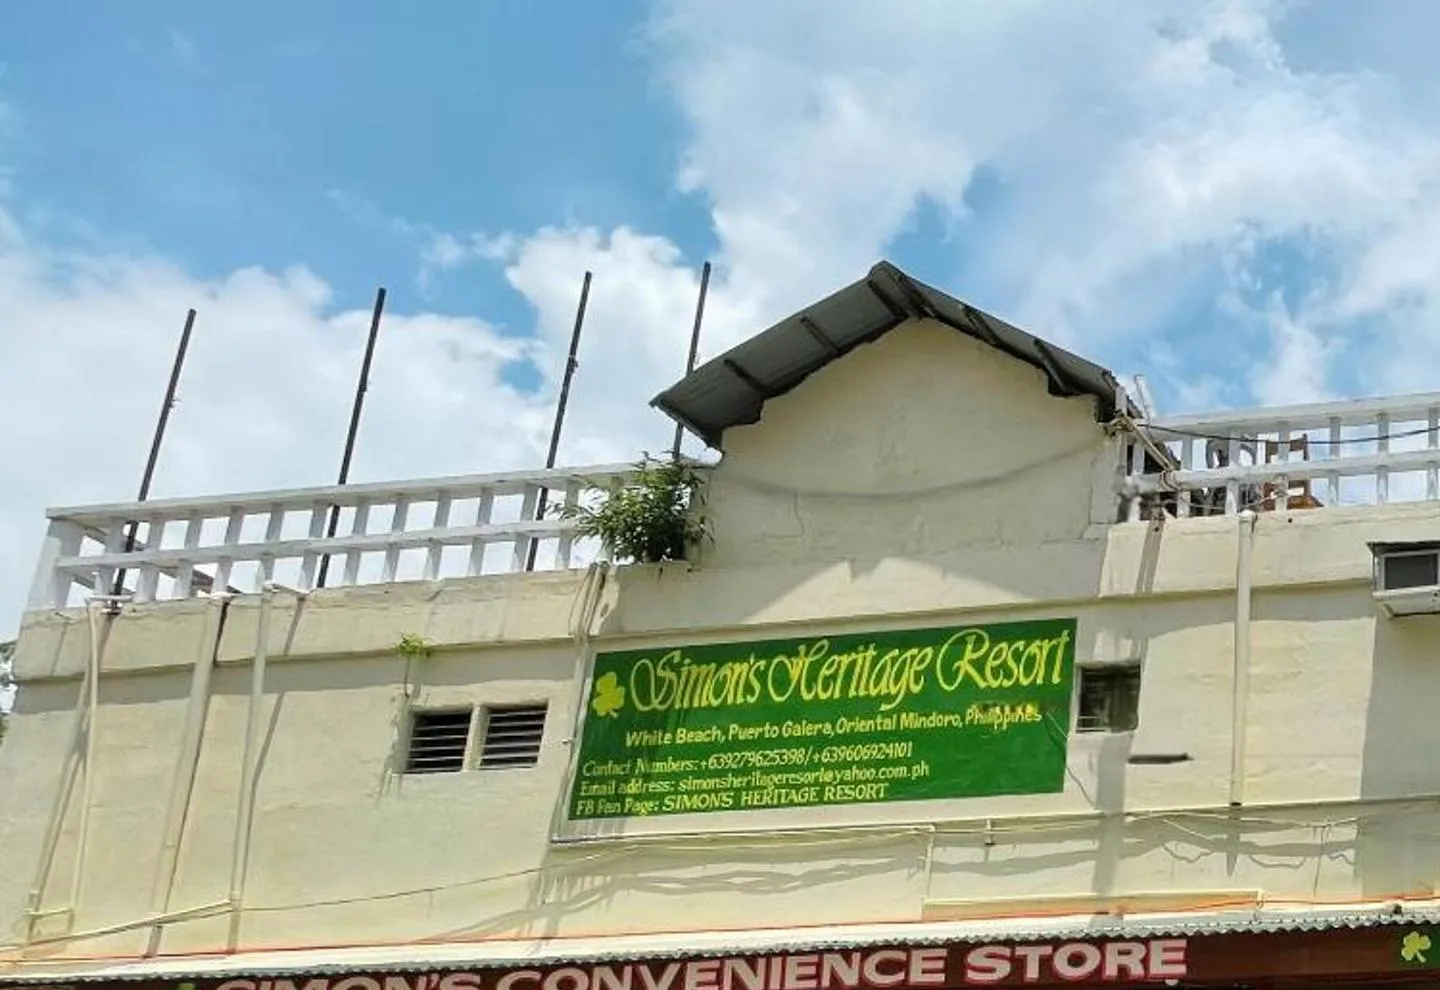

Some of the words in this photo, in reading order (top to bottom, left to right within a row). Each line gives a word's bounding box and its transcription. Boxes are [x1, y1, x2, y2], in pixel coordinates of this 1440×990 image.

[630, 649, 767, 712] Simon's
[767, 638, 934, 712] Heritage
[937, 628, 1070, 692] Resort
[625, 730, 671, 748] White
[675, 725, 726, 744] Beach,
[728, 721, 780, 741] Puerto
[782, 719, 834, 739] Galera,
[836, 712, 898, 734] Oriental
[899, 711, 964, 730] Mindoro,
[965, 704, 1042, 731] Philippines
[580, 779, 616, 796] Email
[617, 776, 675, 795] address:
[582, 758, 630, 777] Contact
[576, 799, 594, 816] FB
[597, 797, 621, 814] Fan
[623, 797, 659, 817] Page:
[740, 786, 820, 807] HERITAGE
[822, 782, 890, 802] RESORT
[964, 938, 1189, 984] STORE
